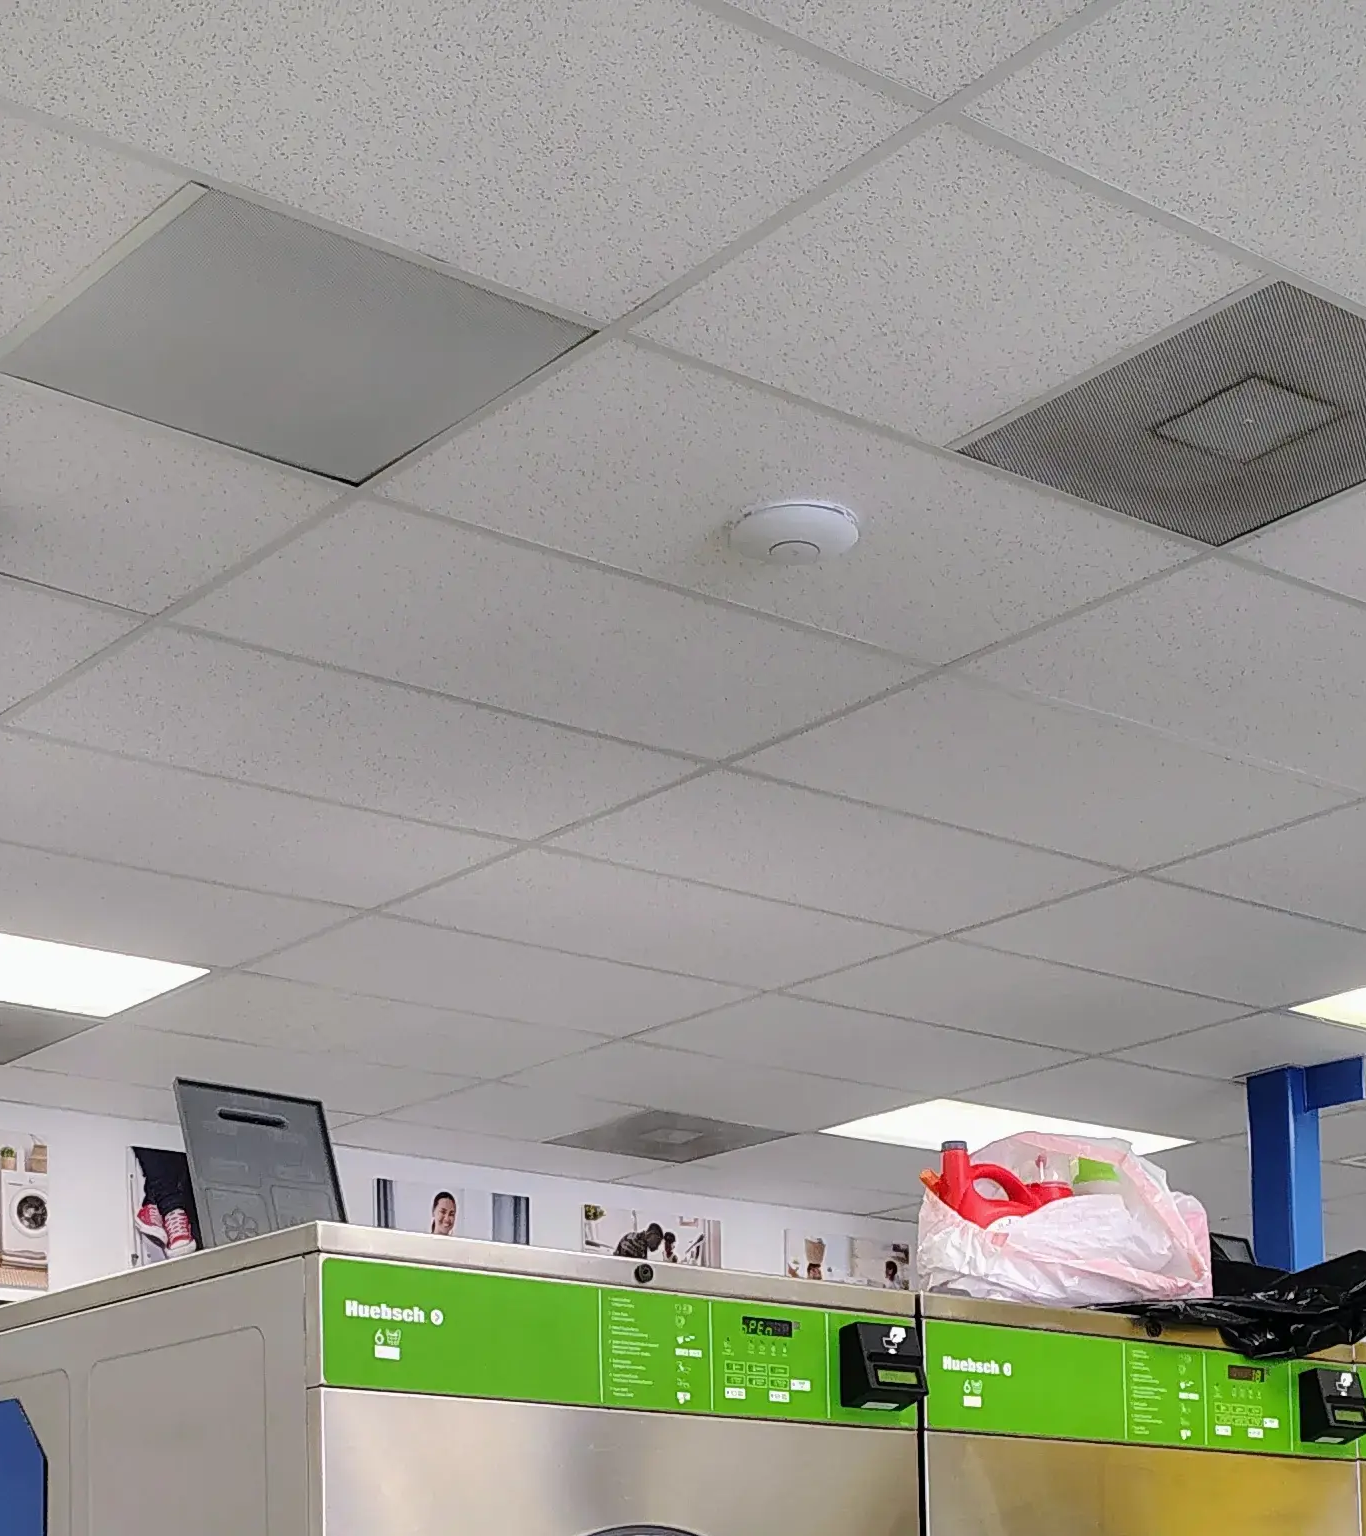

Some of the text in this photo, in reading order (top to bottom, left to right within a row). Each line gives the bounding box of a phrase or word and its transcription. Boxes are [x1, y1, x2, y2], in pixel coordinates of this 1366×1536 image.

[344, 1299, 425, 1324] Huebsch
[374, 1328, 385, 1345] 6
[942, 1355, 1001, 1375] Huebsch
[963, 1379, 972, 1394] 6
